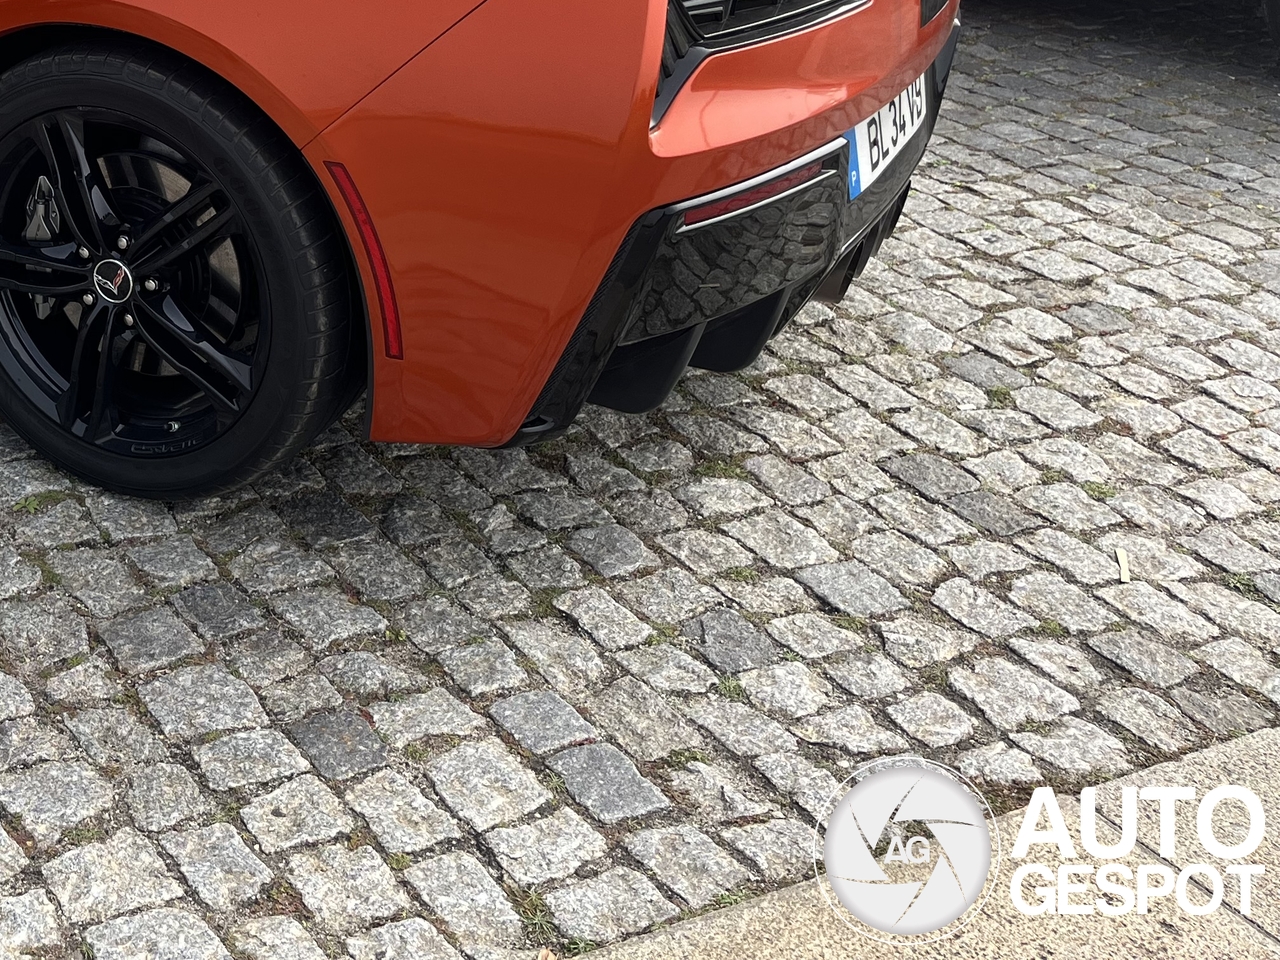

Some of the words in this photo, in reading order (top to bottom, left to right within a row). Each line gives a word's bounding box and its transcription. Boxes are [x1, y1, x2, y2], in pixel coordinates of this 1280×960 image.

[867, 110, 890, 173] BL
[888, 93, 907, 148] 34
[851, 171, 857, 187] P
